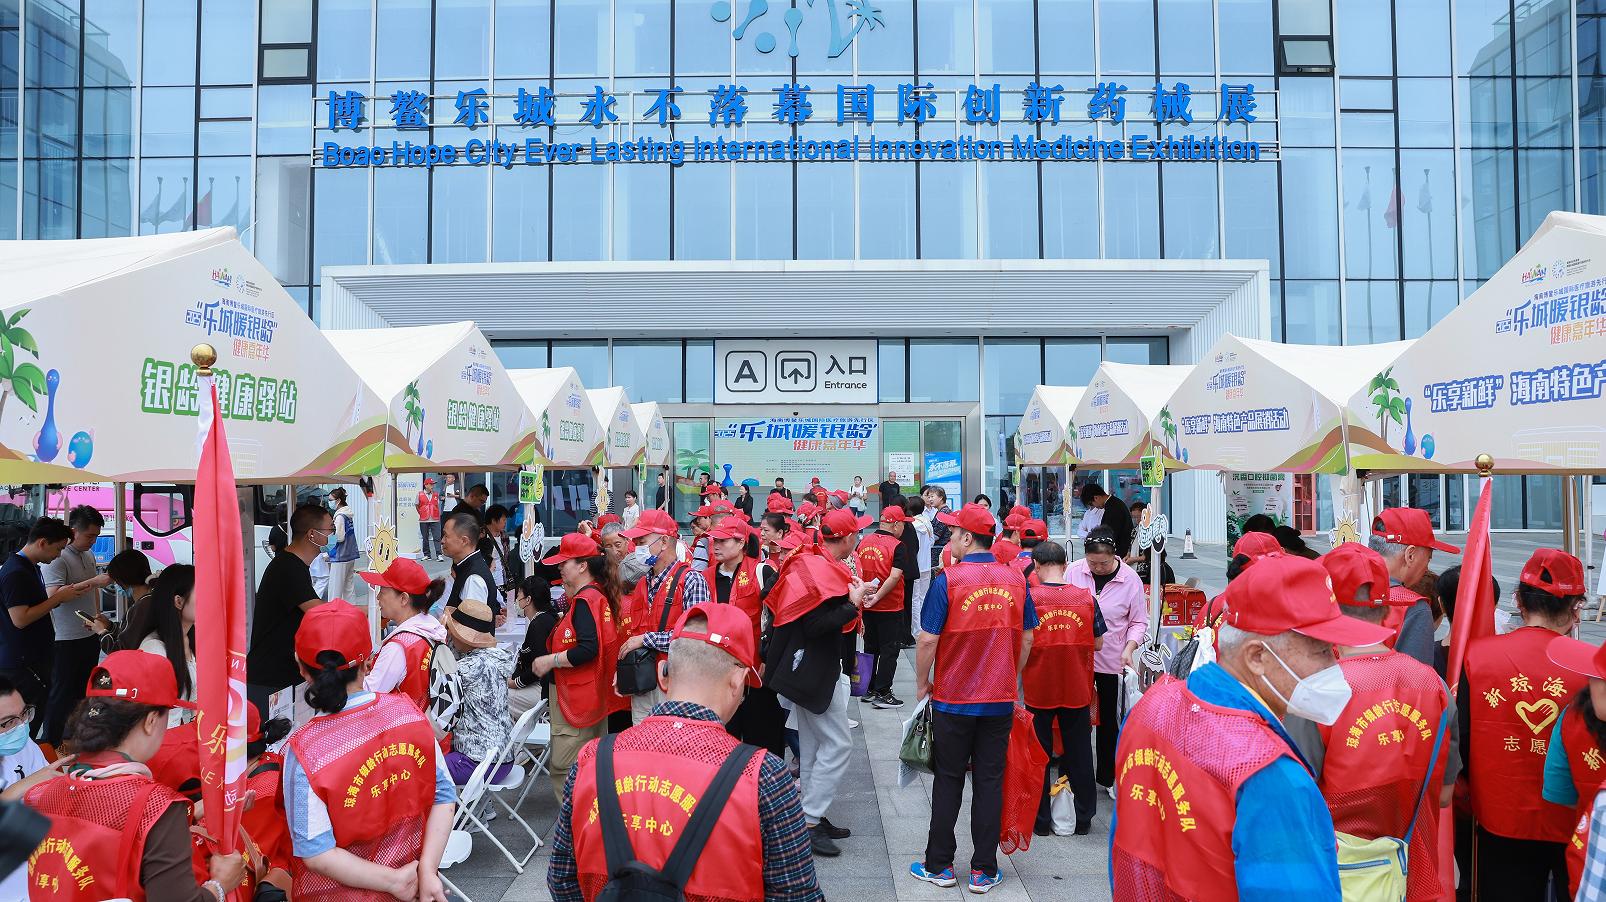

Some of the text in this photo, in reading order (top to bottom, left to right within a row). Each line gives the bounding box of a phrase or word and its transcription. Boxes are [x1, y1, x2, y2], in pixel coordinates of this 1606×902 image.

[326, 83, 1258, 130] 博鳌乐城永不落幕国际创新药械展
[323, 133, 1260, 169] Boao Hope City Ever Lasting International Innovation Medicine Exhibition
[733, 359, 759, 384] A
[824, 354, 867, 375] 入口
[141, 358, 297, 424] 银龄健康驿站
[824, 381, 868, 389] Entrance
[1423, 374, 1504, 413] “乐享新鲜”
[1482, 672, 1567, 709] 新琼海
[1581, 747, 1606, 771] 新
[370, 769, 412, 799] 乐享中心
